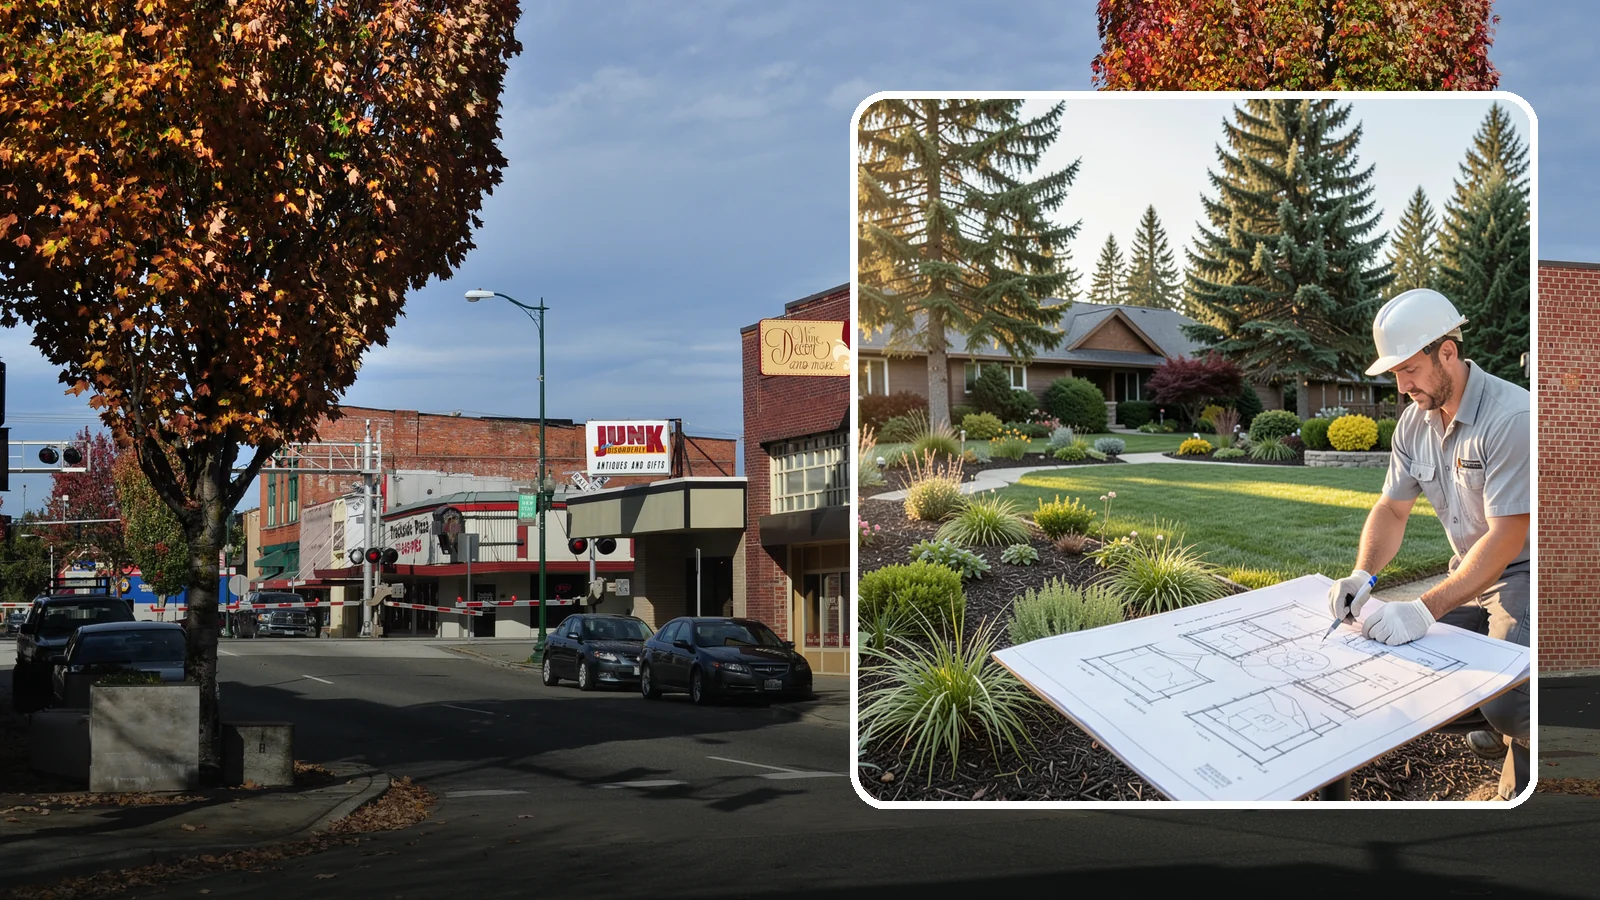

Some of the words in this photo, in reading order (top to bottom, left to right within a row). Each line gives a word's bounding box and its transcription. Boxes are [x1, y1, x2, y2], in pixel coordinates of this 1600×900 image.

[596, 425, 665, 457] JUNK
[607, 446, 646, 454] DISORDERLY
[597, 461, 628, 470] ANTIQUES
[631, 461, 644, 470] AND
[647, 460, 665, 469] GIFTS
